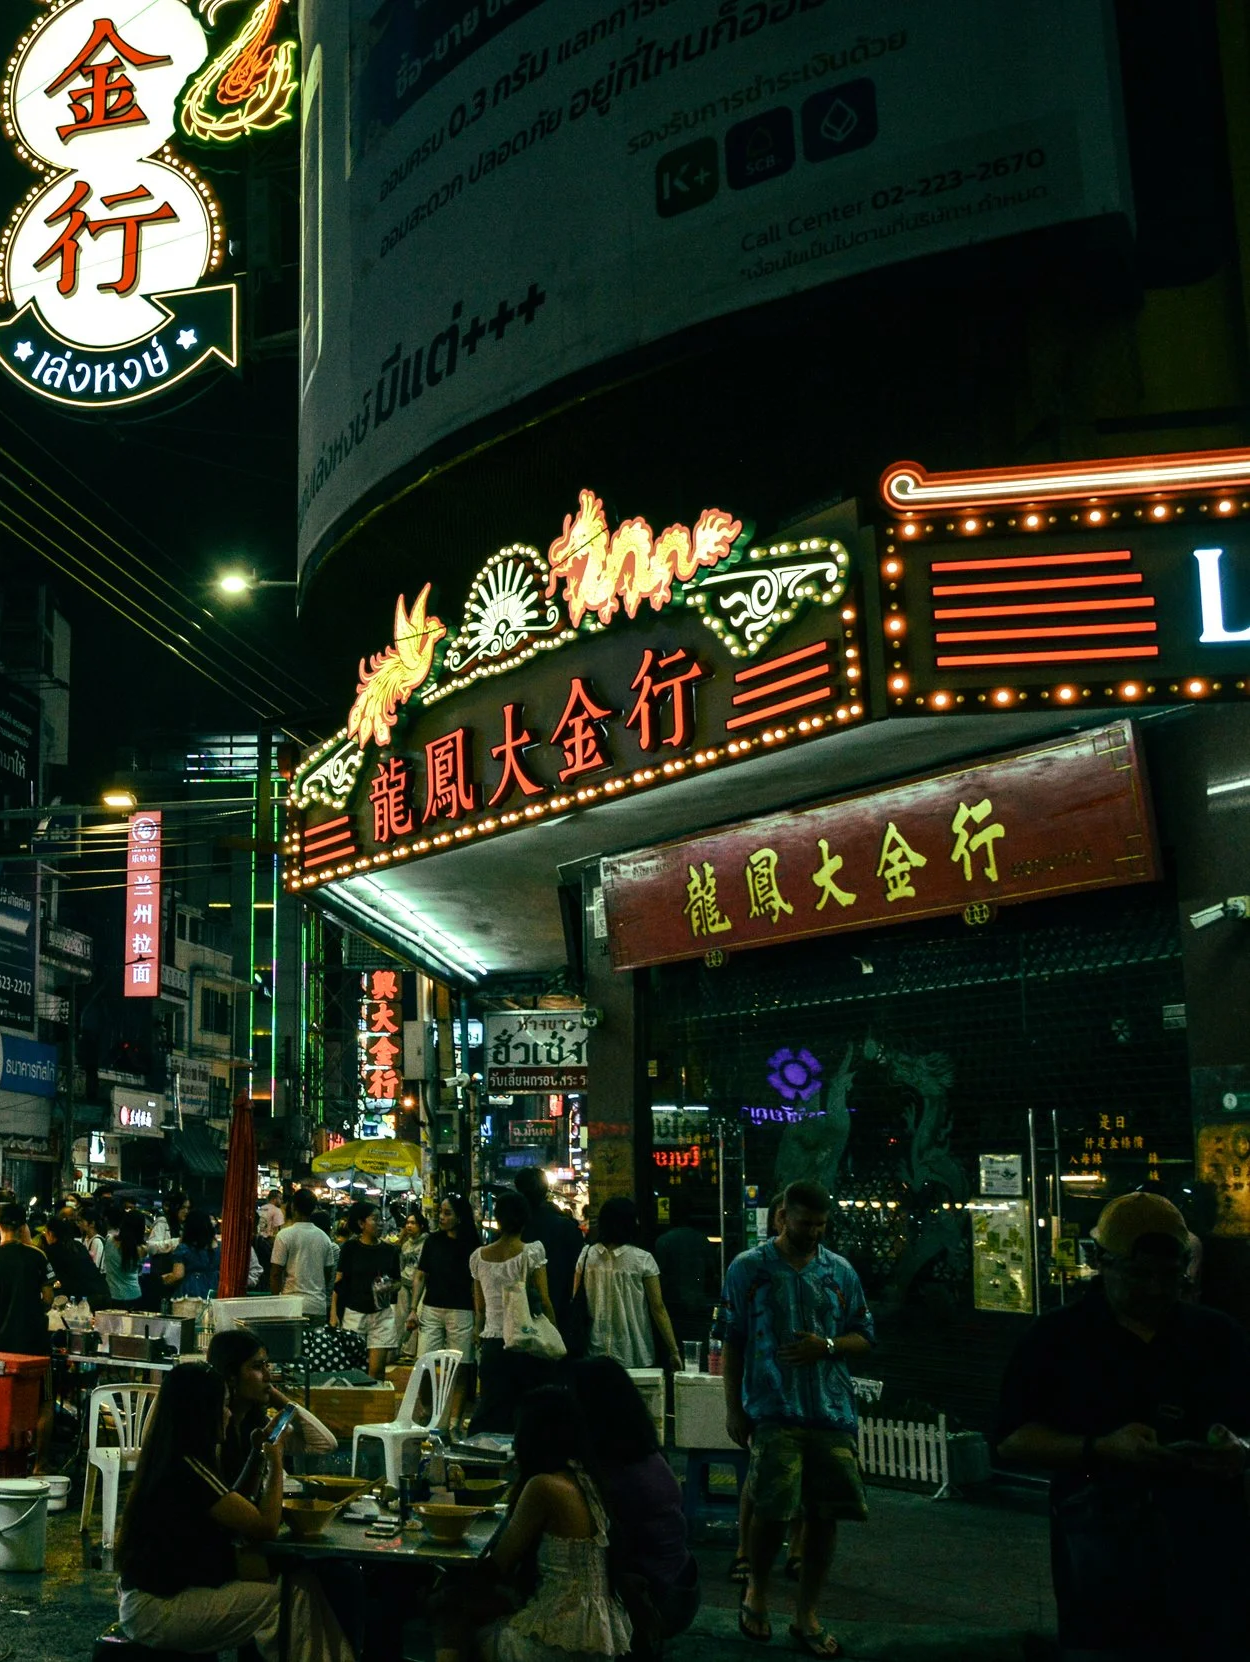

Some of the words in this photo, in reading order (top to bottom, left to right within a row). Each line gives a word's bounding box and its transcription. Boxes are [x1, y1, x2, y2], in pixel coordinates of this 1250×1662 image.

[661, 163, 713, 201] K+
[741, 223, 782, 252] Call
[787, 200, 866, 236] Center
[871, 148, 1046, 210] 02-223-2670
[31, 336, 170, 394] เล่งหงษ์
[368, 648, 703, 844] 龍鳳大金行
[683, 798, 1006, 938] 龍鳳大金行
[132, 875, 153, 984] 兰州拉面
